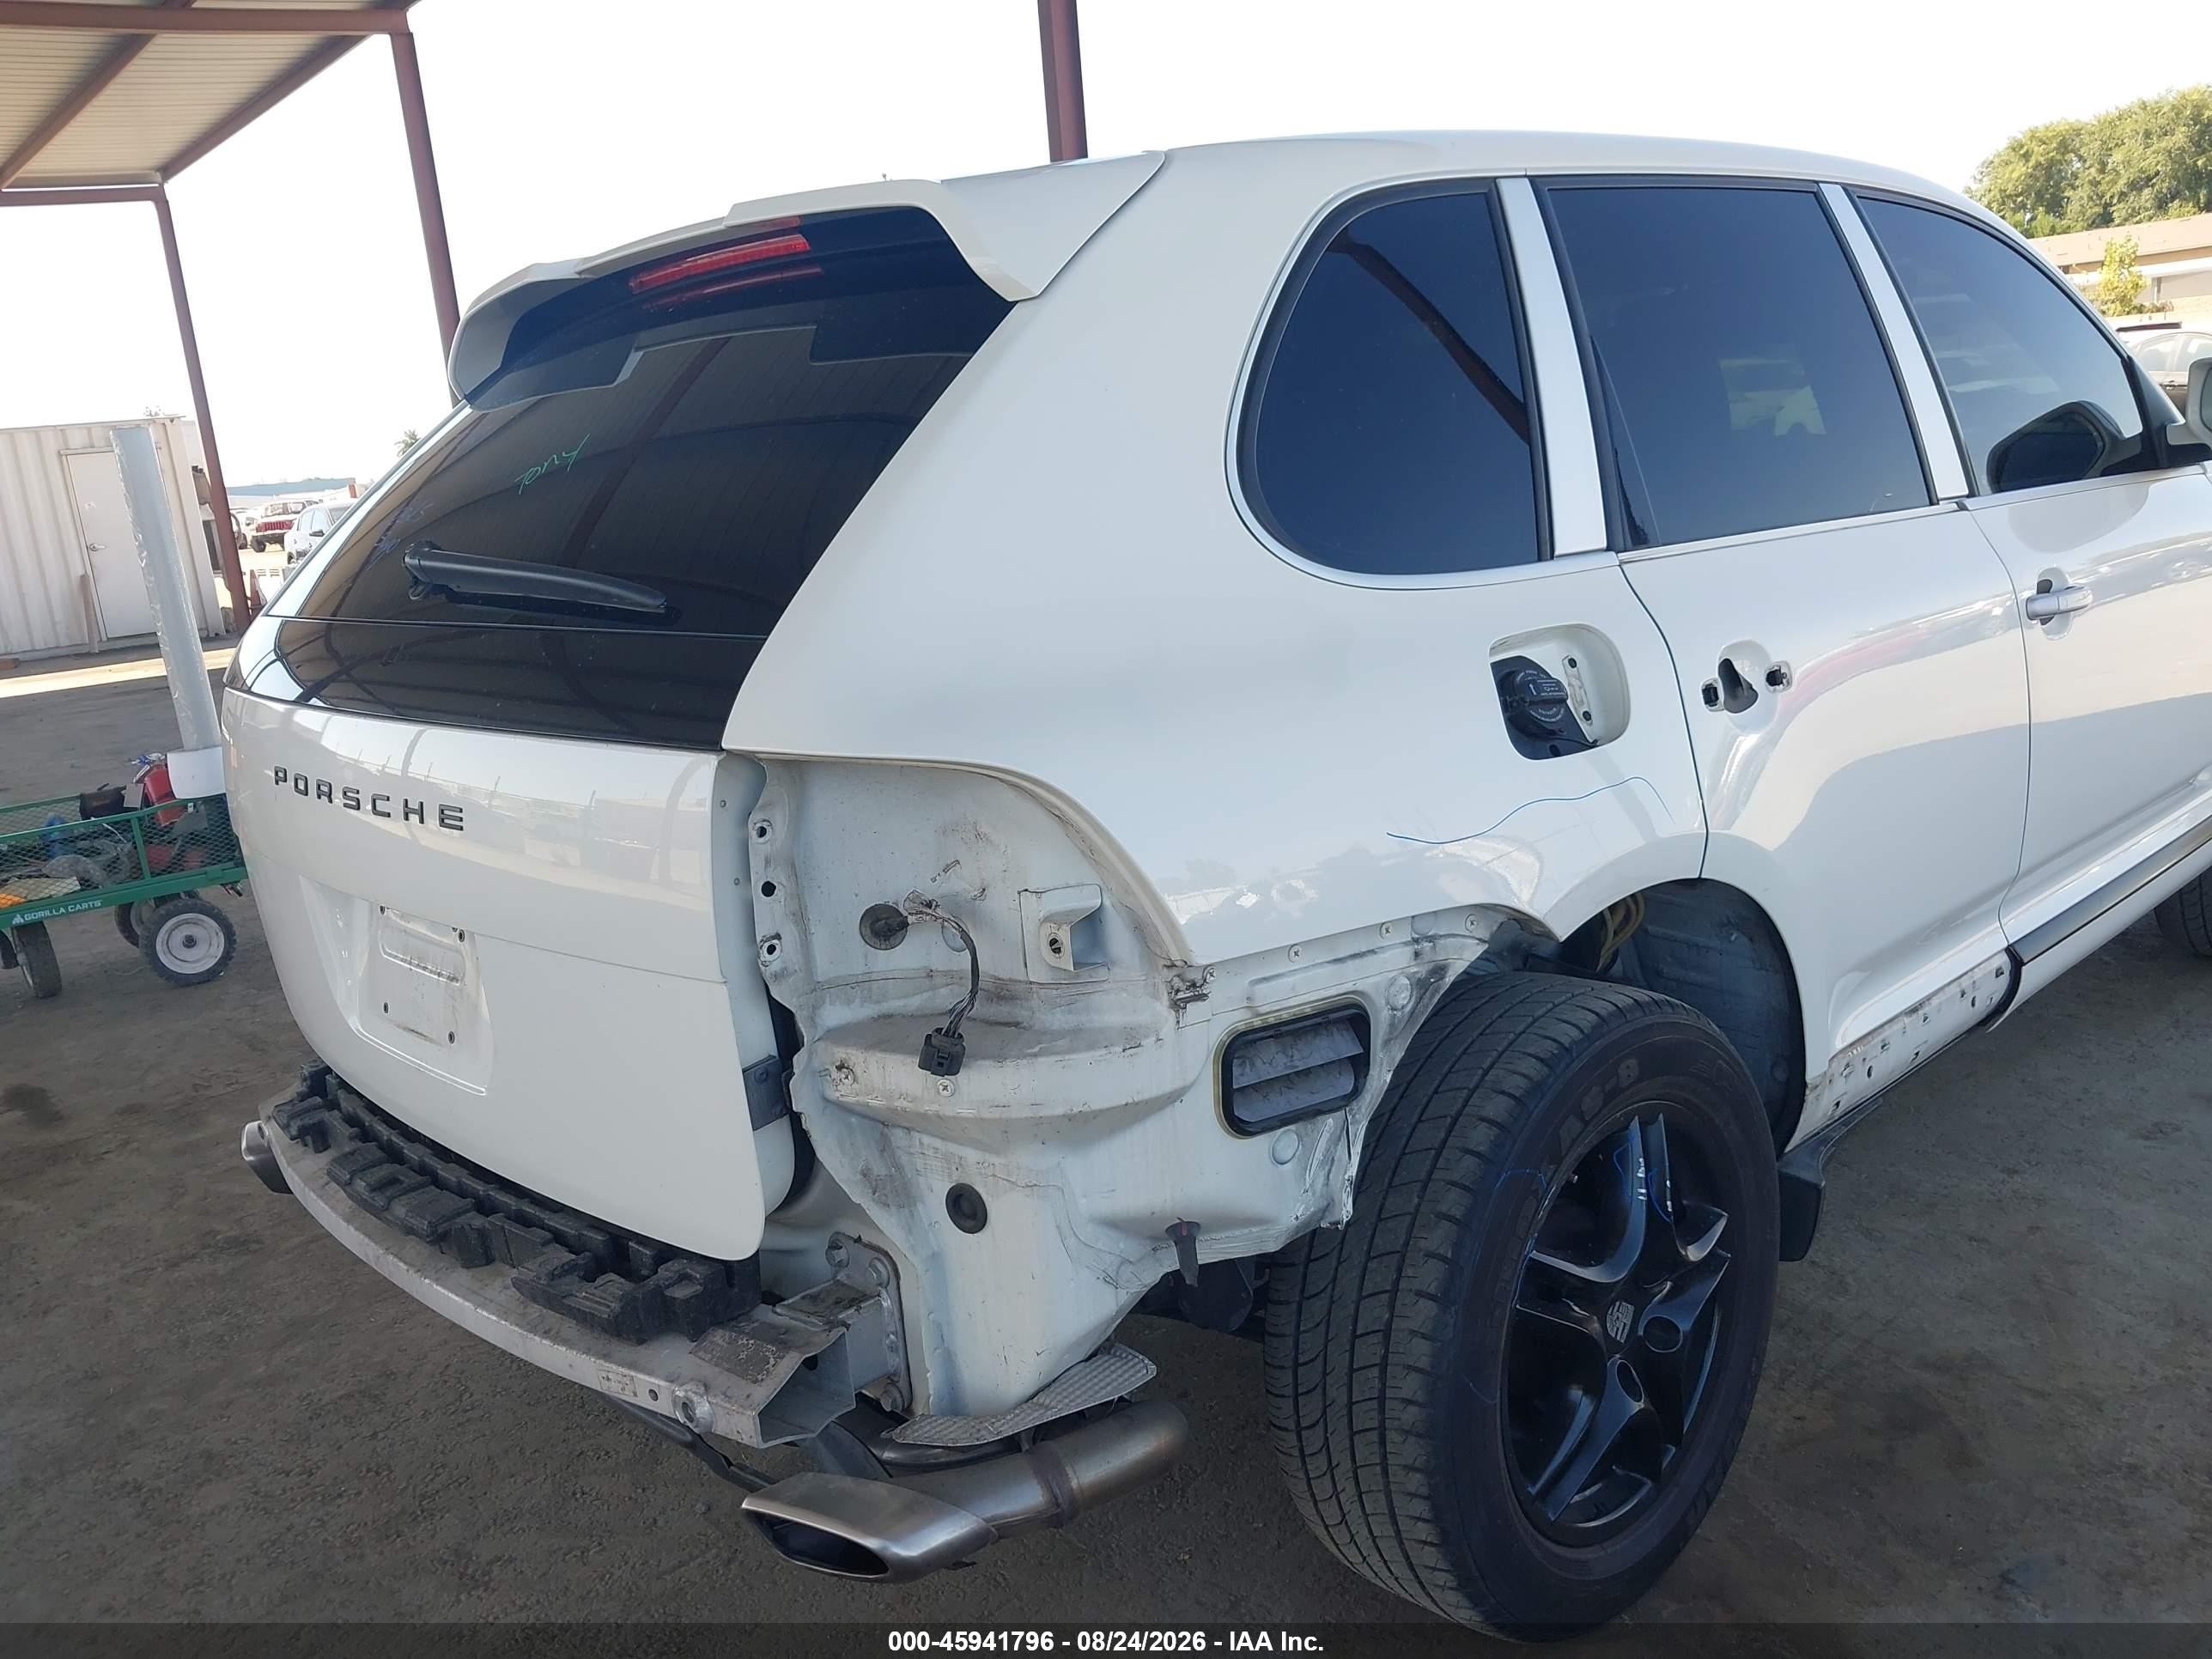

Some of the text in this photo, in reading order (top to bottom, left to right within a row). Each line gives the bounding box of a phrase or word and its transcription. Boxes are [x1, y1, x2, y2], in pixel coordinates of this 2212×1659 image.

[273, 764, 465, 831] PORSCHE
[24, 899, 103, 921] GORILLA CARTS
